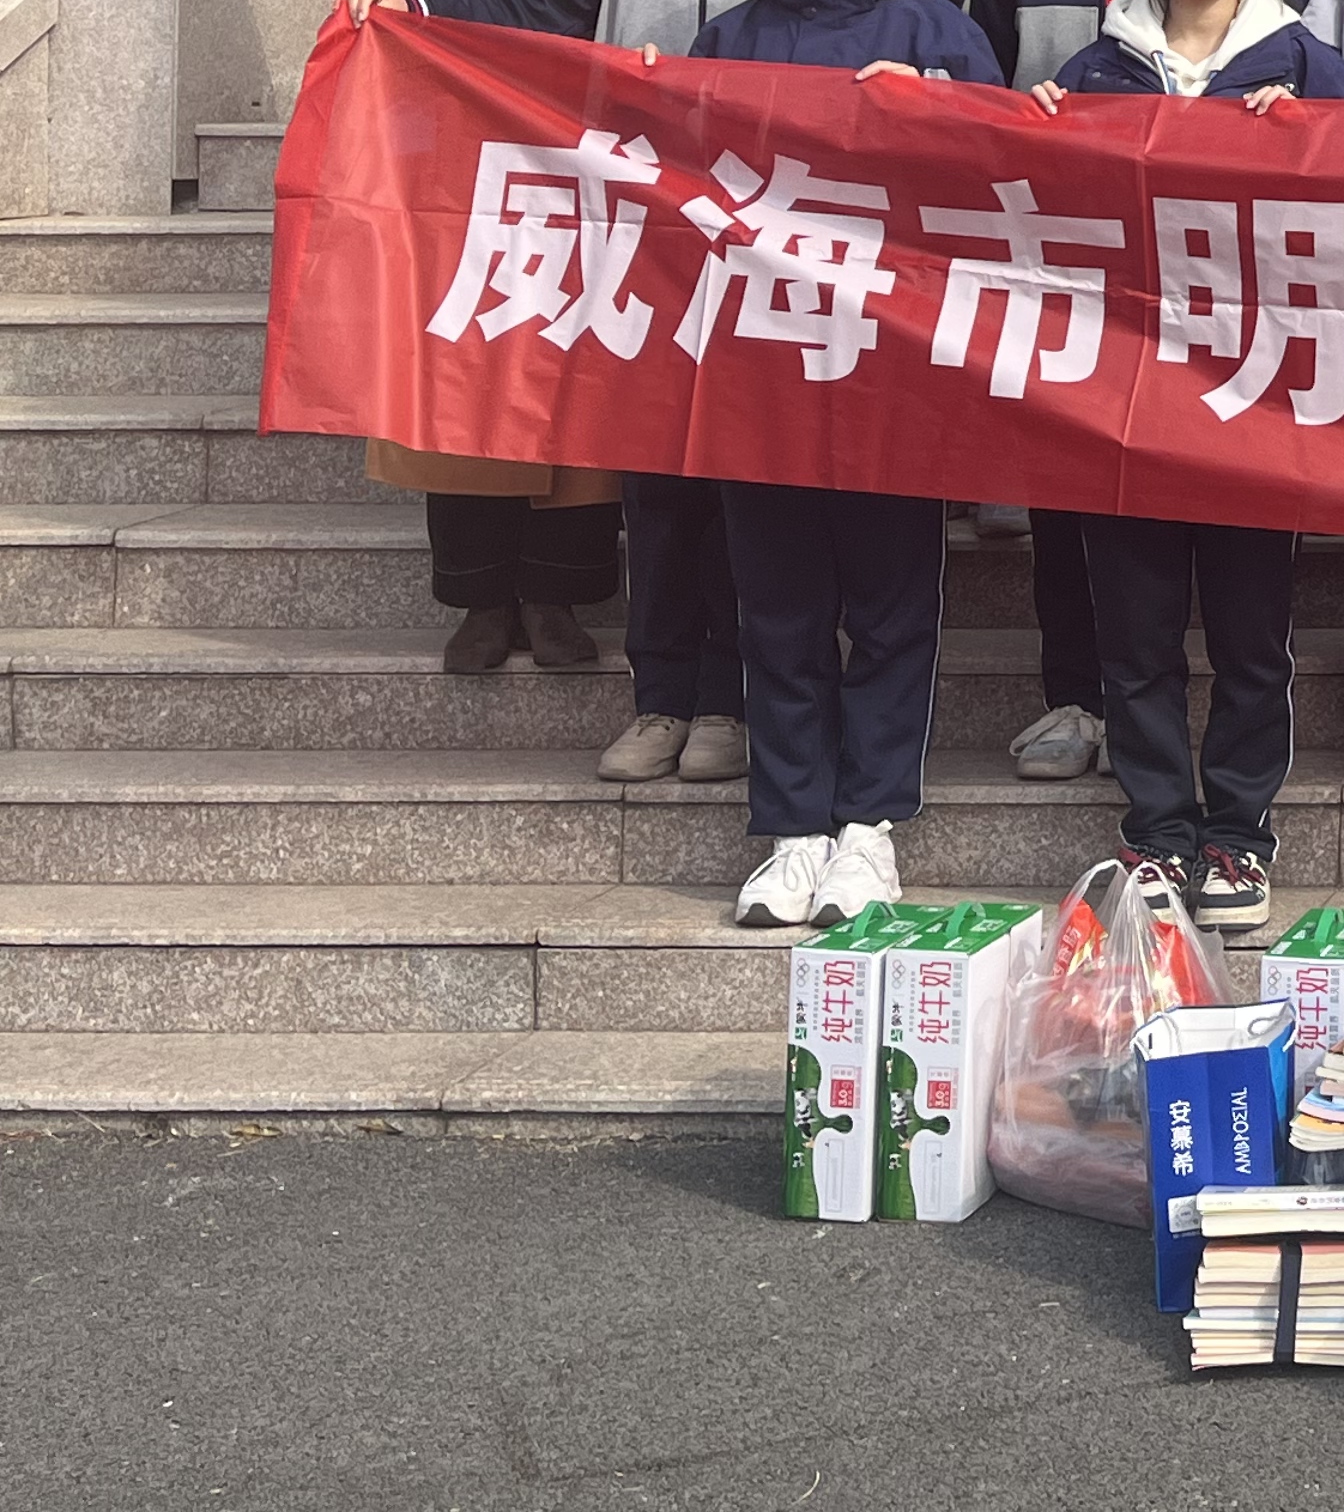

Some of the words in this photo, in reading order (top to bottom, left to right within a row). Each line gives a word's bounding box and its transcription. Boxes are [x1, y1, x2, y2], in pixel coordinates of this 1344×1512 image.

[821, 960, 856, 1044] 纯牛奶
[917, 961, 951, 1044] 纯牛奶
[1295, 967, 1329, 1050] 纯牛奶
[1169, 1099, 1194, 1176] 安慕希
